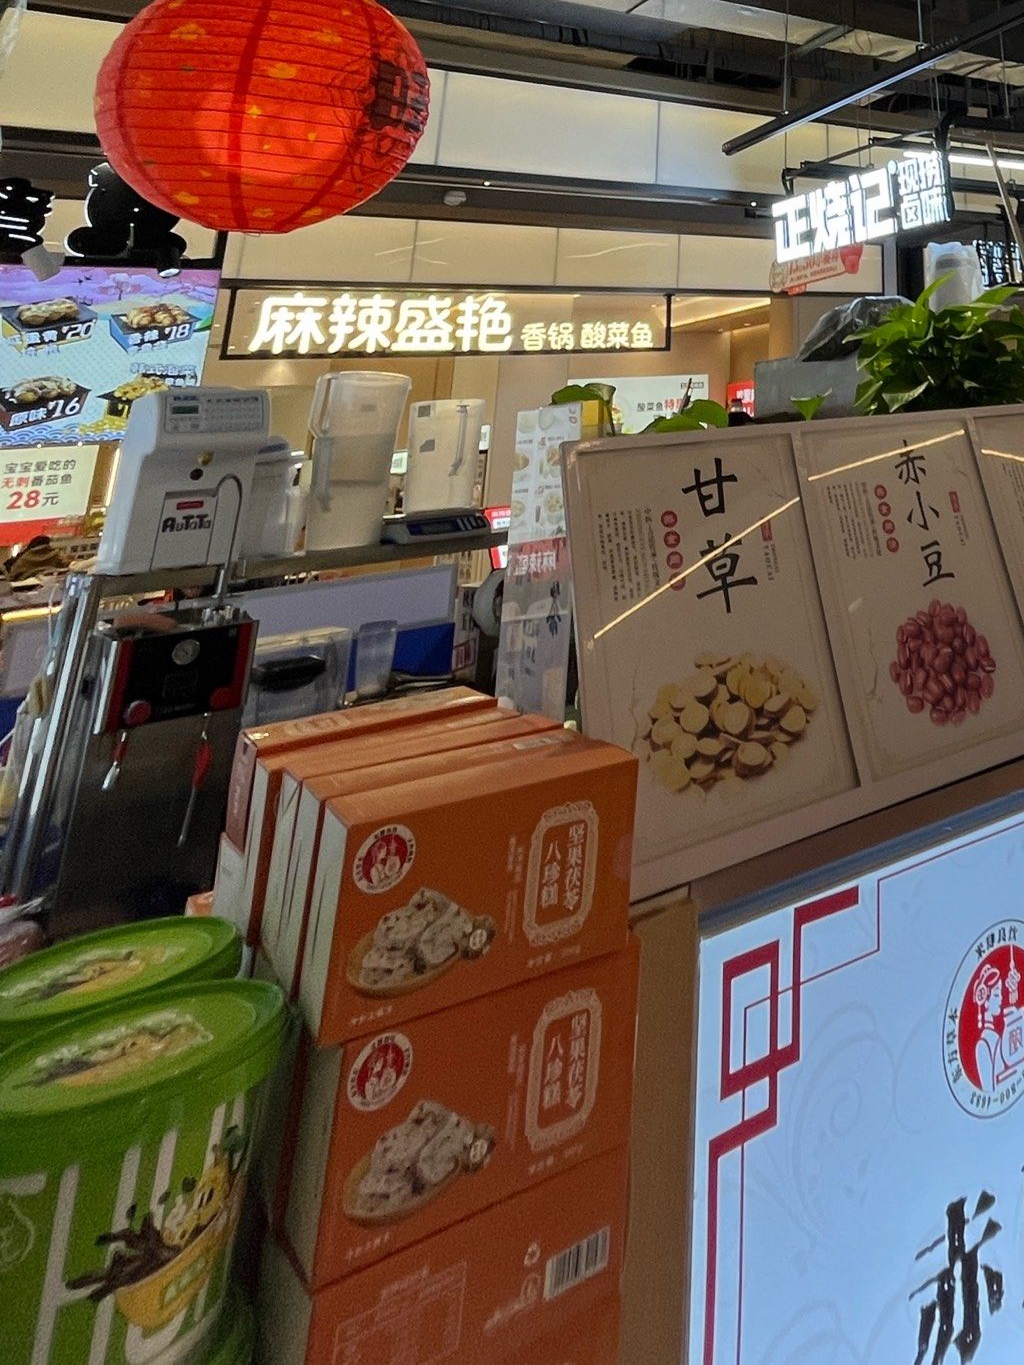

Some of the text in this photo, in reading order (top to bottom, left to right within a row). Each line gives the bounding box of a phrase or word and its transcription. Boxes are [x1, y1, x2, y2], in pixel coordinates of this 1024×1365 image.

[248, 292, 654, 355] 麻辣盛艳 香锅 酸菜鱼
[1, 473, 73, 489] 无刺番茄鱼
[4, 459, 77, 475] 宝宝爱吃的
[6, 489, 60, 511] 28元
[895, 439, 955, 587] 赤小豆
[681, 457, 758, 614] 甘草
